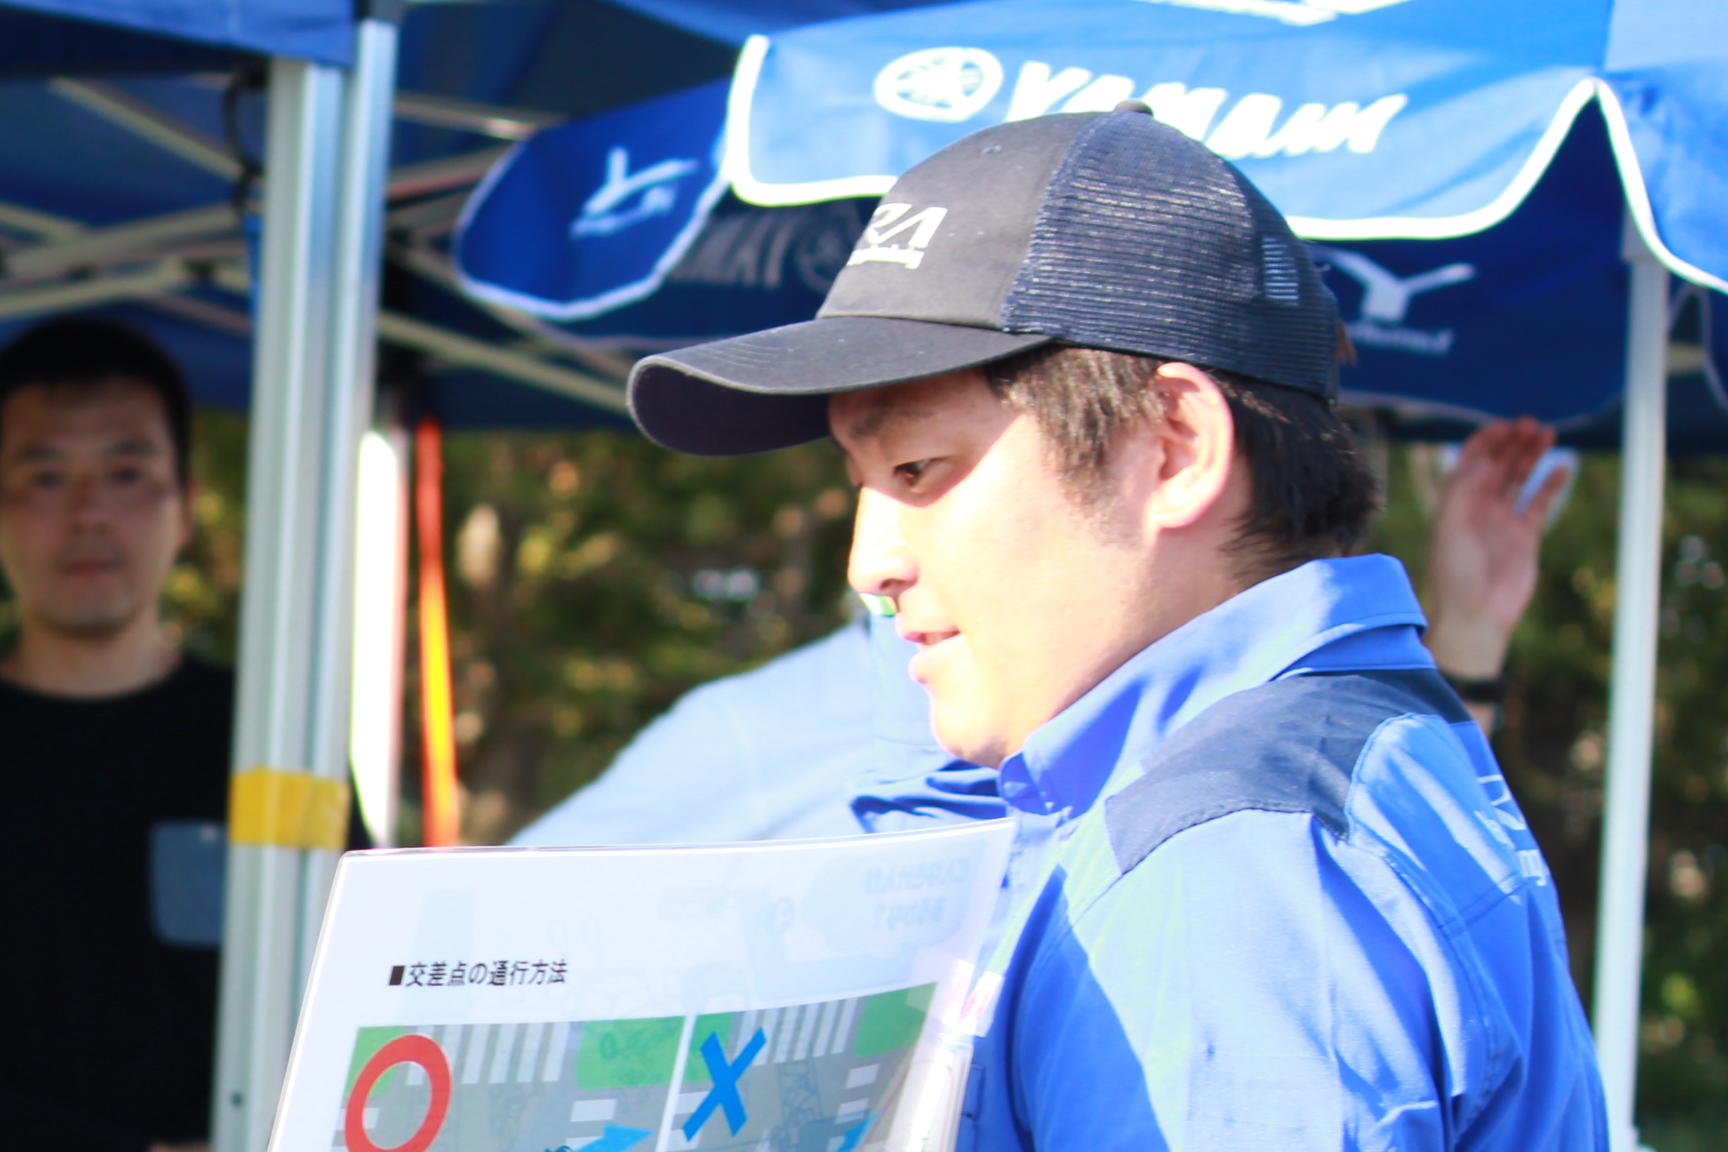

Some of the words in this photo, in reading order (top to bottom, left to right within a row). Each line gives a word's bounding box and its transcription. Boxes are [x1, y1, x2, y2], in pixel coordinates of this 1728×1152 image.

[405, 958, 569, 988] 交差点の通行方法
